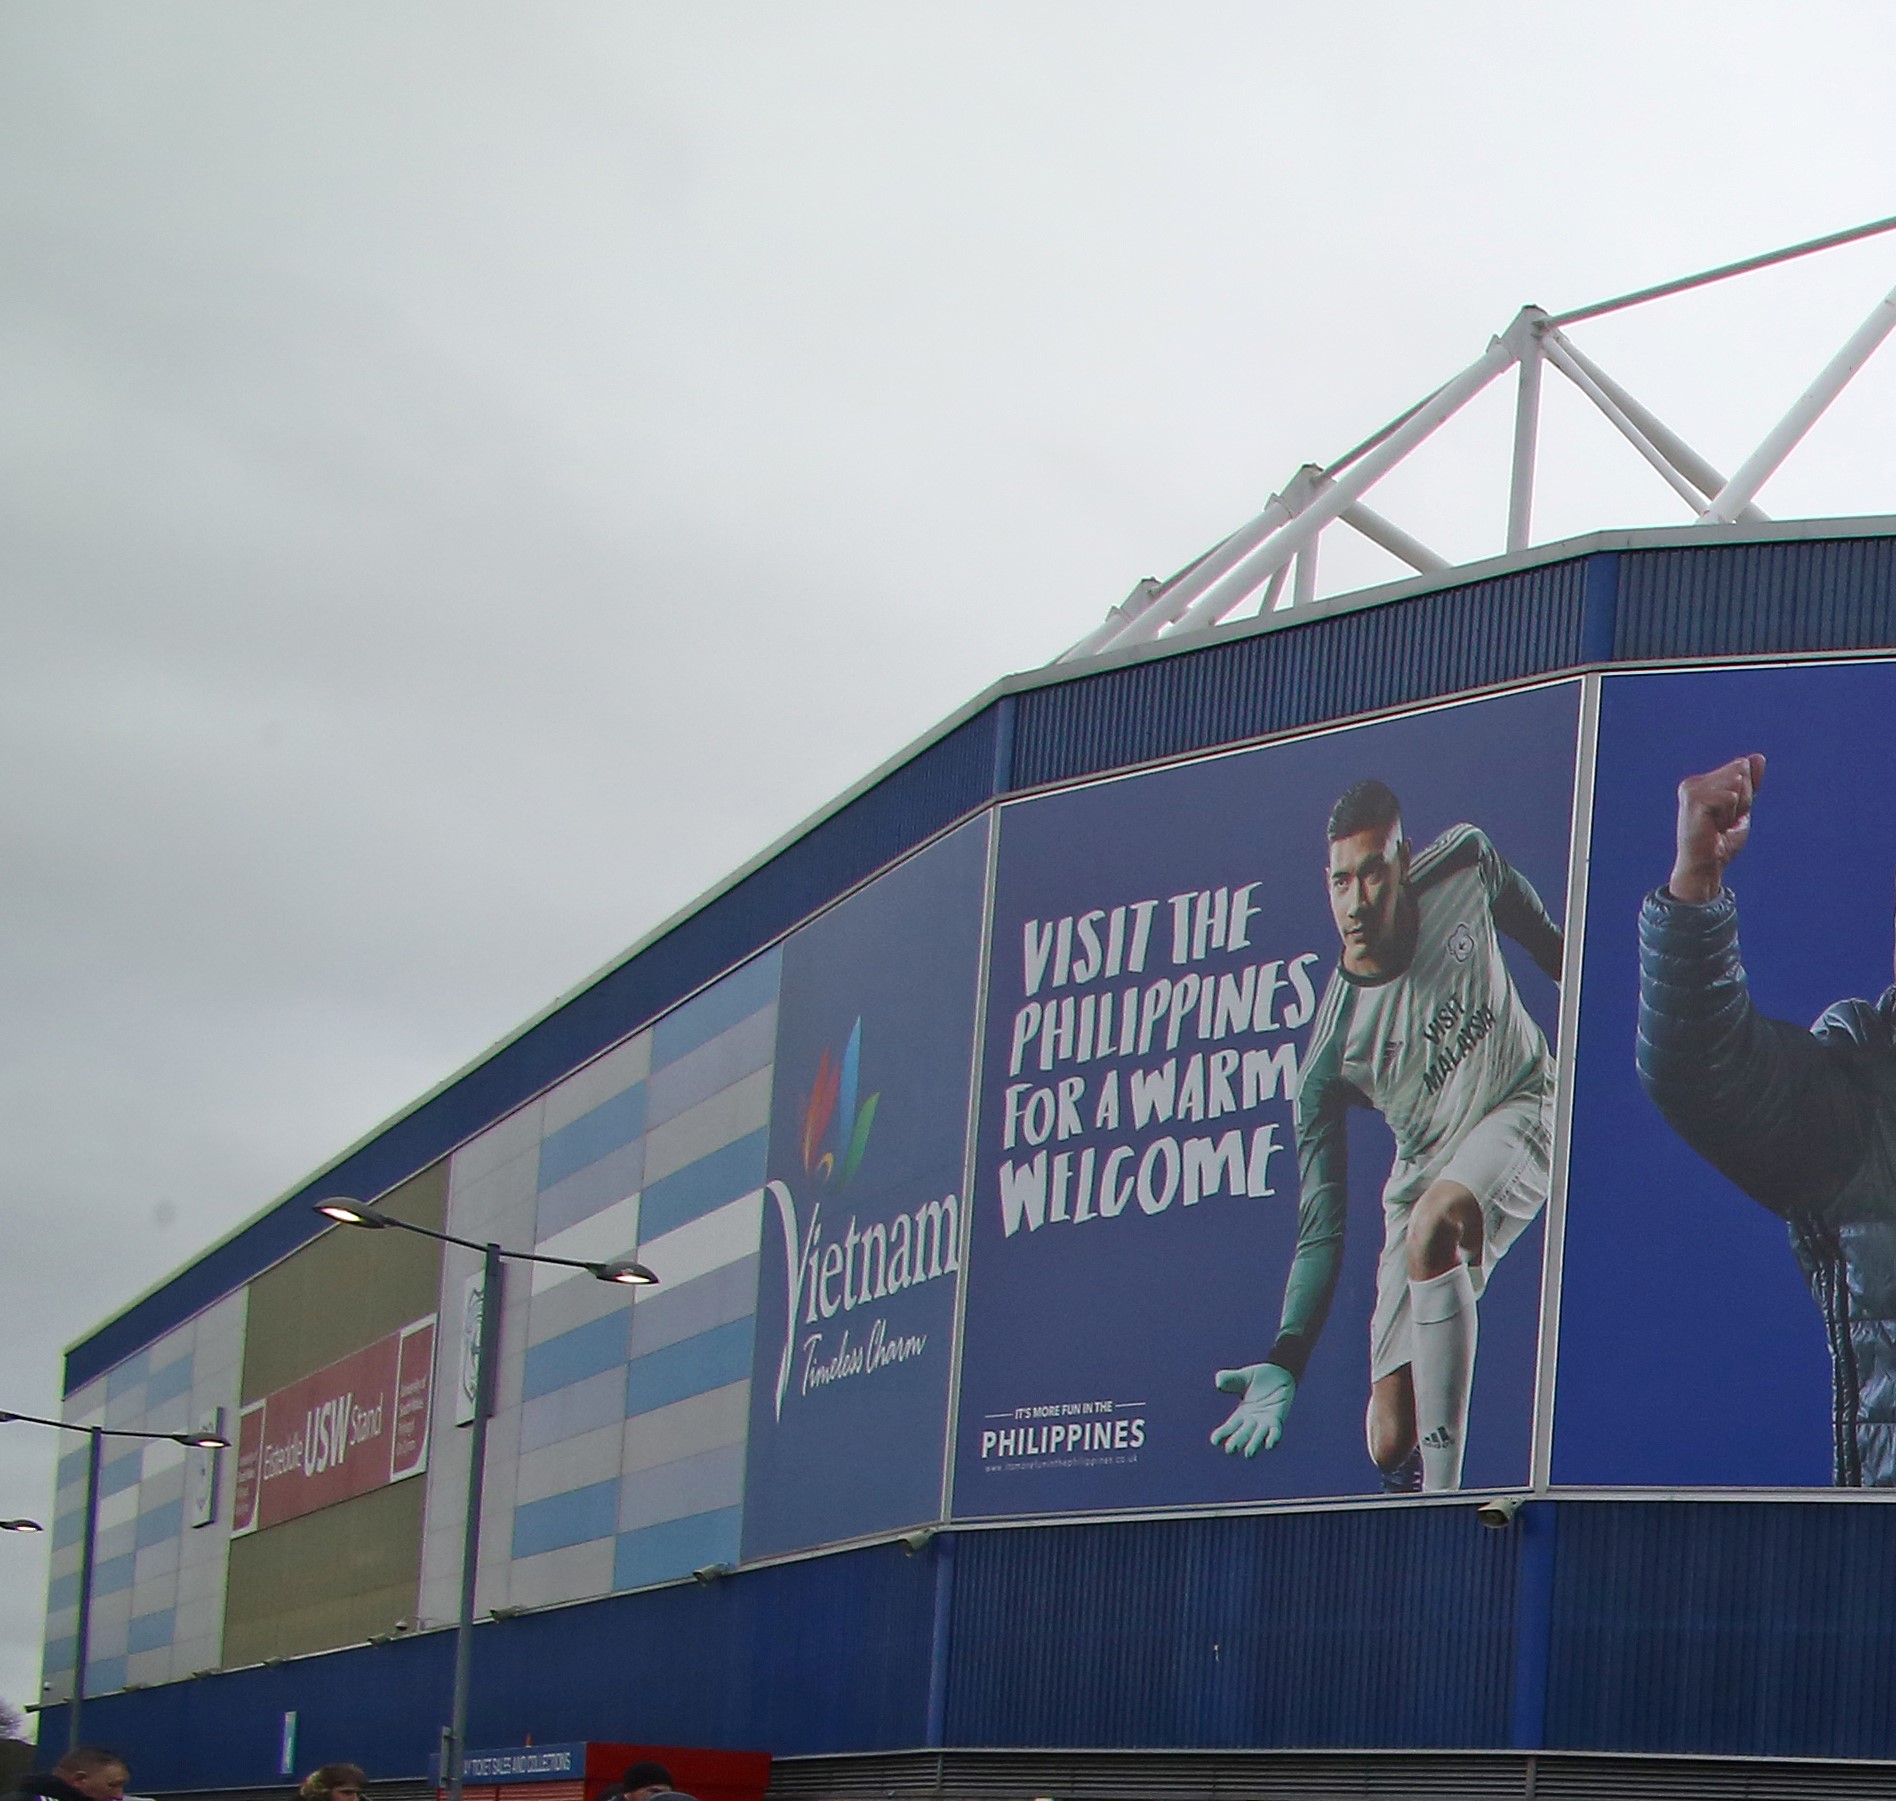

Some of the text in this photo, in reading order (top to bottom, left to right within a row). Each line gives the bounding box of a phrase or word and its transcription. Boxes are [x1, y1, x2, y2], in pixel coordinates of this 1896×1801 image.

[1024, 881, 1262, 997] VISIT THE
[1009, 952, 1319, 1076] PHILIPPINES
[1003, 1042, 1298, 1150] FOR A WARM
[999, 1123, 1283, 1238] WELCOME
[767, 1180, 960, 1422] Vietnam
[803, 1318, 927, 1396] Timeless Charm
[1015, 1400, 1113, 1420] IT'S MORE FUN IN THE
[304, 1392, 352, 1478] USW
[350, 1392, 384, 1446] Stand
[981, 1418, 1147, 1458] PHILIPPINES
